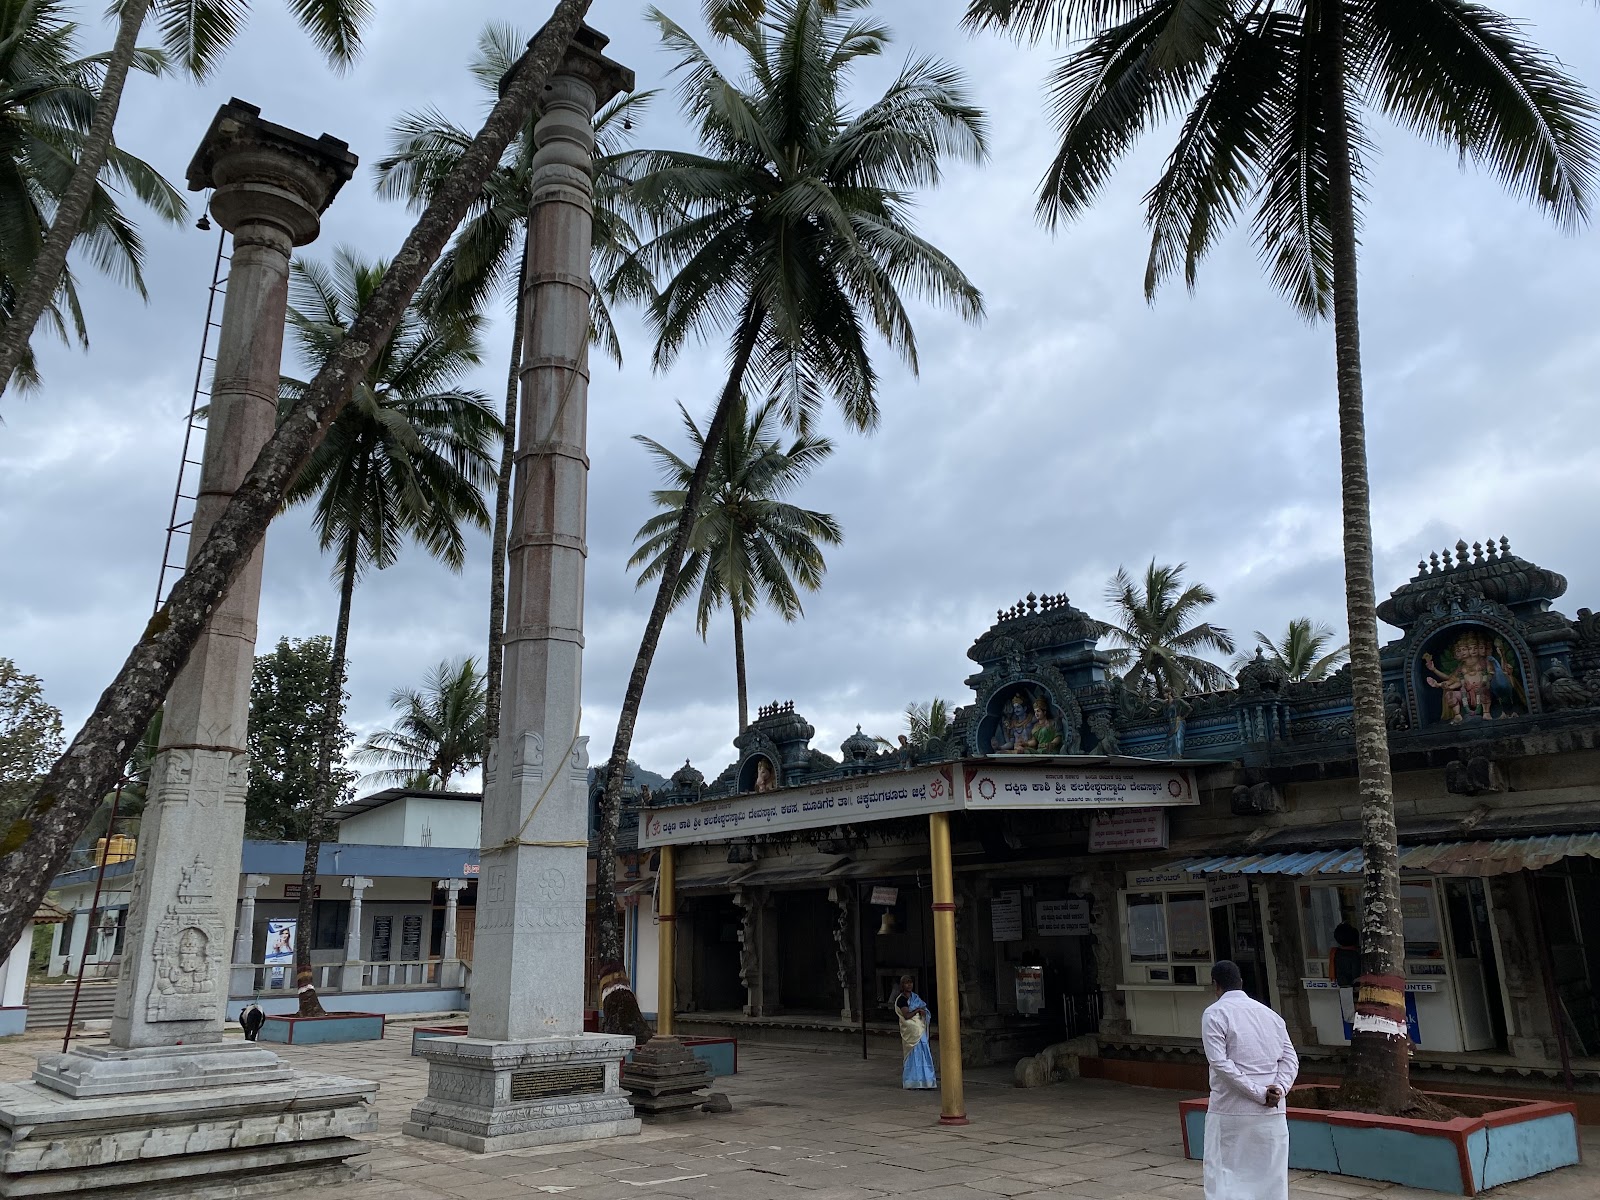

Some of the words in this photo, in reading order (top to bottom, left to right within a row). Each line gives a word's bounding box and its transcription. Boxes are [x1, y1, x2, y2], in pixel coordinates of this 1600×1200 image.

[1004, 782, 1028, 796] ದಕ್ಷಿಣ
[1032, 781, 1051, 792] ಕಾಶಿ
[1055, 781, 1067, 795] ಶ್ರೀ
[1070, 781, 1127, 795] ಕಲಶೇಶ್ವರಸ್ವಾಮಿ
[1130, 782, 1163, 795] ದೇವಸ್ಥಾನ
[663, 823, 677, 835] ದಕ್ಷಿಣ
[678, 818, 691, 830] ಕಾಶಿ
[693, 818, 701, 831] ಶ್ರೀ
[704, 811, 746, 827] ಕಲಶೇಶ್ವರಸ್ವಾಮಿ
[802, 797, 835, 811] ಮೂಡಿಗೆರೆ
[856, 788, 908, 809] ಚಿಕ್ಕಮಗಳೂರು
[912, 785, 927, 801] ಜಿಲ್ಲೆ
[1136, 876, 1154, 886] ಪ್ರಸಾದ
[1156, 873, 1181, 882] ಕೌಂಟರ್
